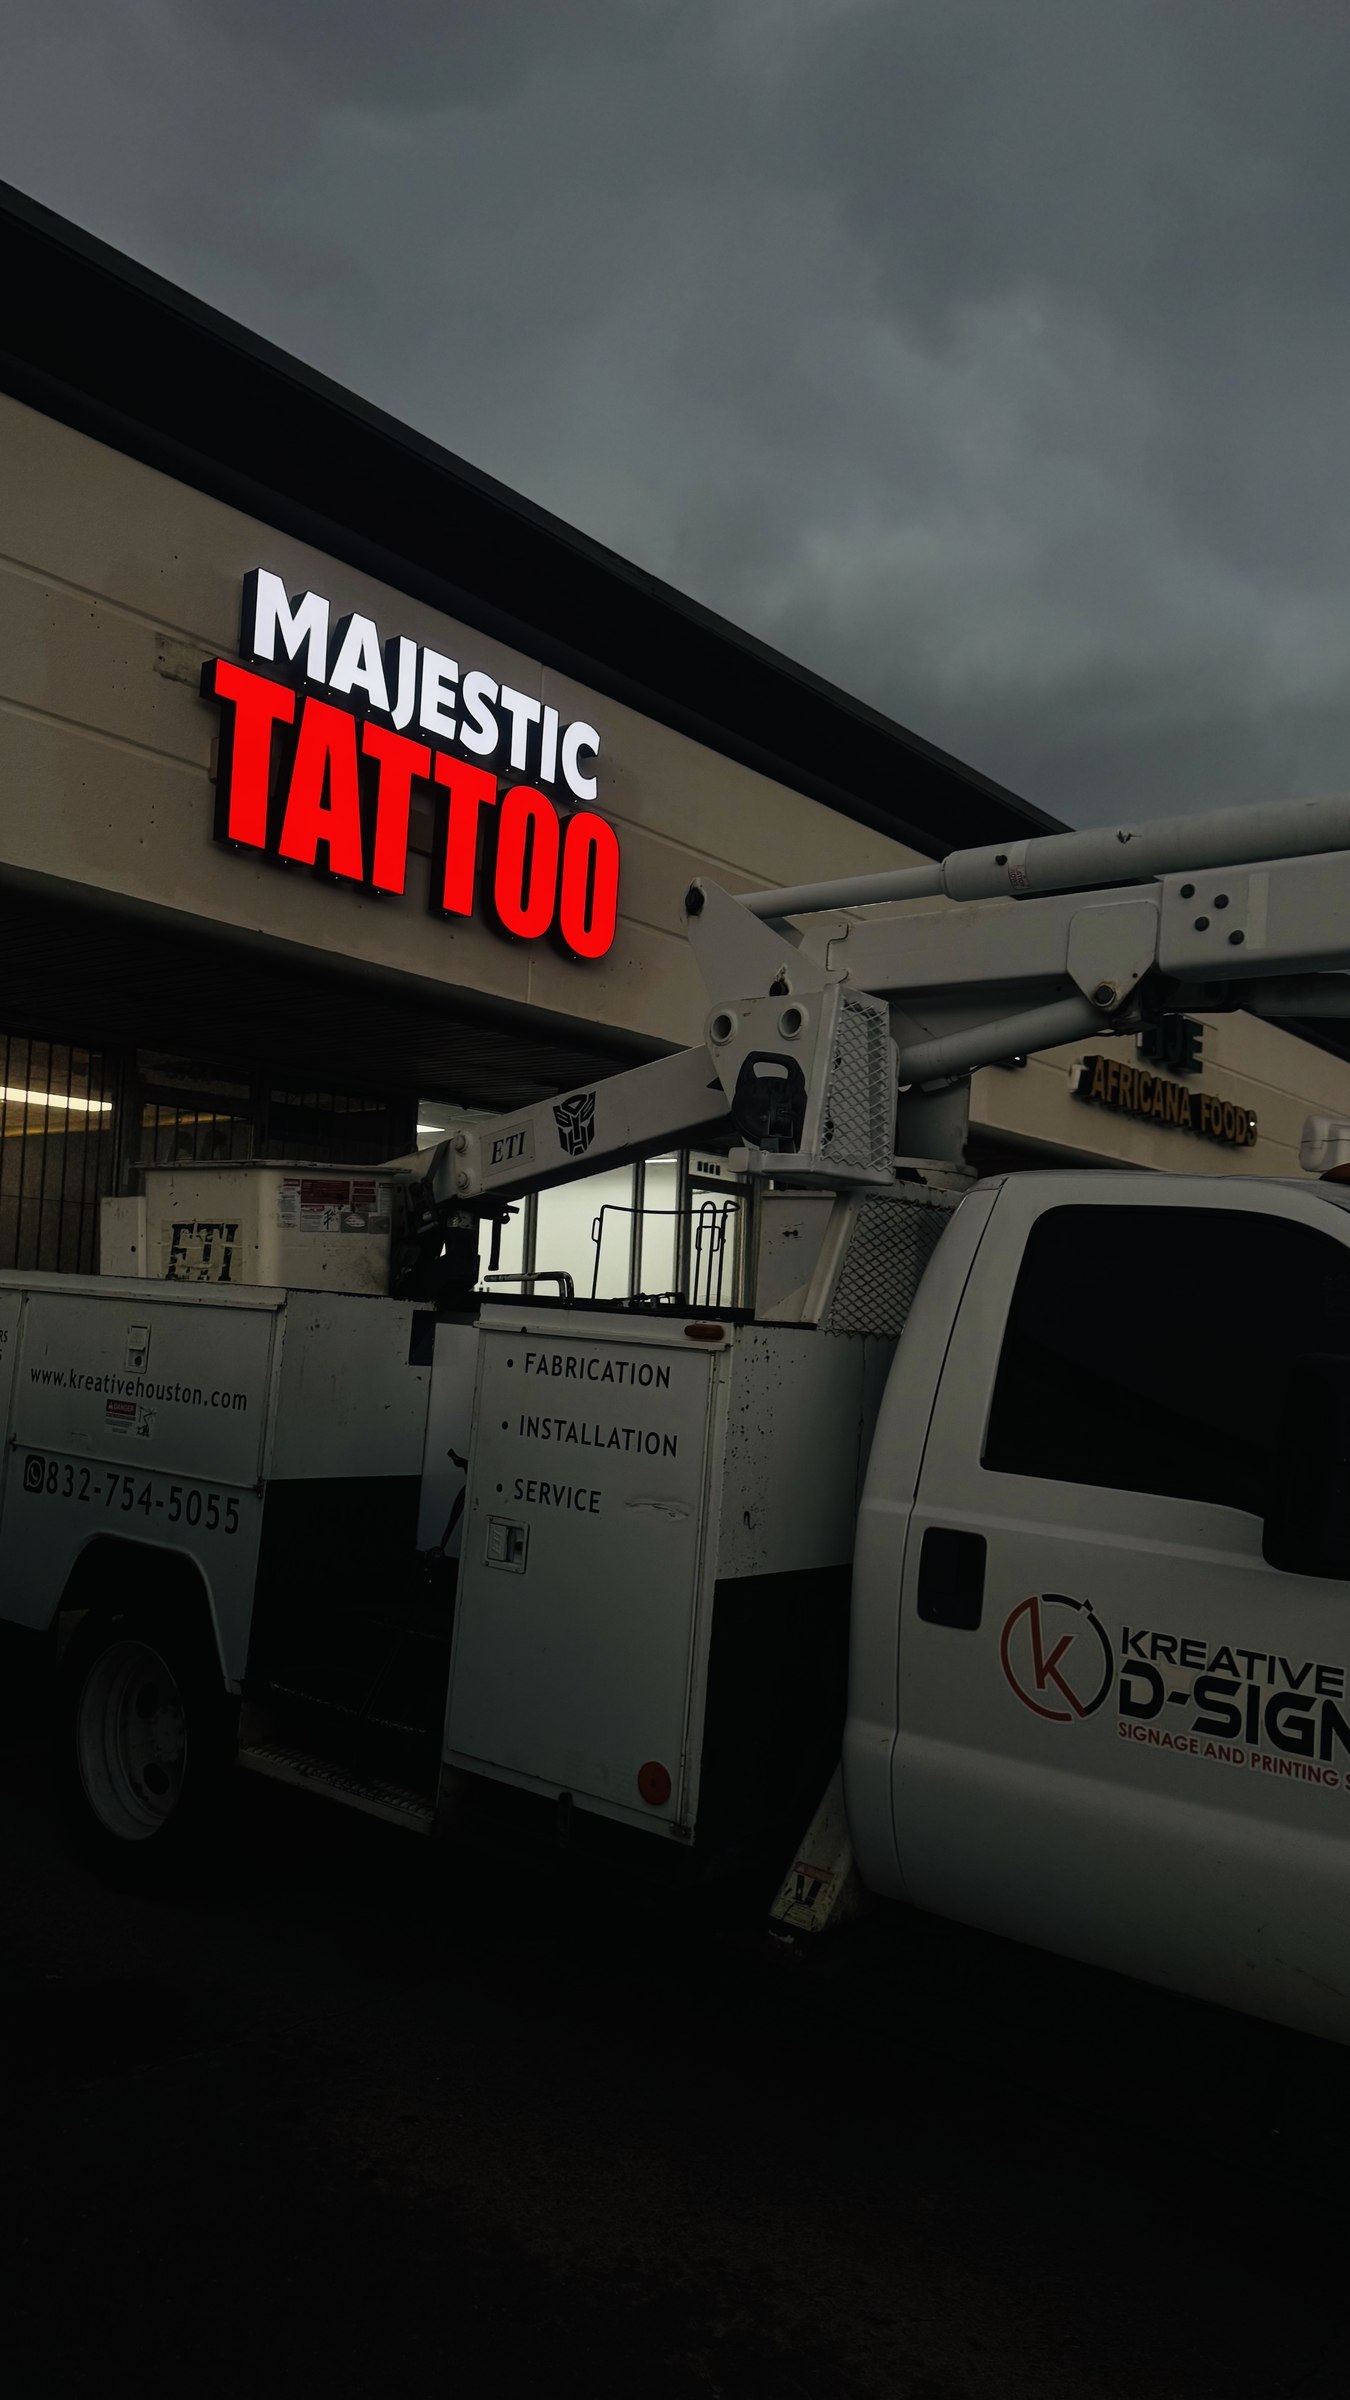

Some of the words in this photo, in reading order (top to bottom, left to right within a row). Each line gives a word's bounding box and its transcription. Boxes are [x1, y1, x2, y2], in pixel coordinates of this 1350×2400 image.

[252, 566, 601, 801] MAJESTIC
[213, 656, 621, 960] TATTOO
[1090, 1055, 1192, 1128] AFRICANA
[1200, 1093, 1257, 1147] FOODS
[490, 1131, 526, 1165] ETI
[166, 1223, 239, 1281] ETI
[30, 1367, 248, 1411] www.kreativehouston.com
[525, 1352, 671, 1388] FABRICATION
[519, 1415, 678, 1457] INSTALLATION
[46, 1461, 240, 1535] 832-754-5055
[513, 1478, 602, 1513] SERVICE
[1122, 1626, 1345, 1699] KREATIVE
[1118, 1722, 1199, 1755] SIGNAGE
[1203, 1742, 1246, 1765] AND
[1251, 1753, 1339, 1788] PRINTING
